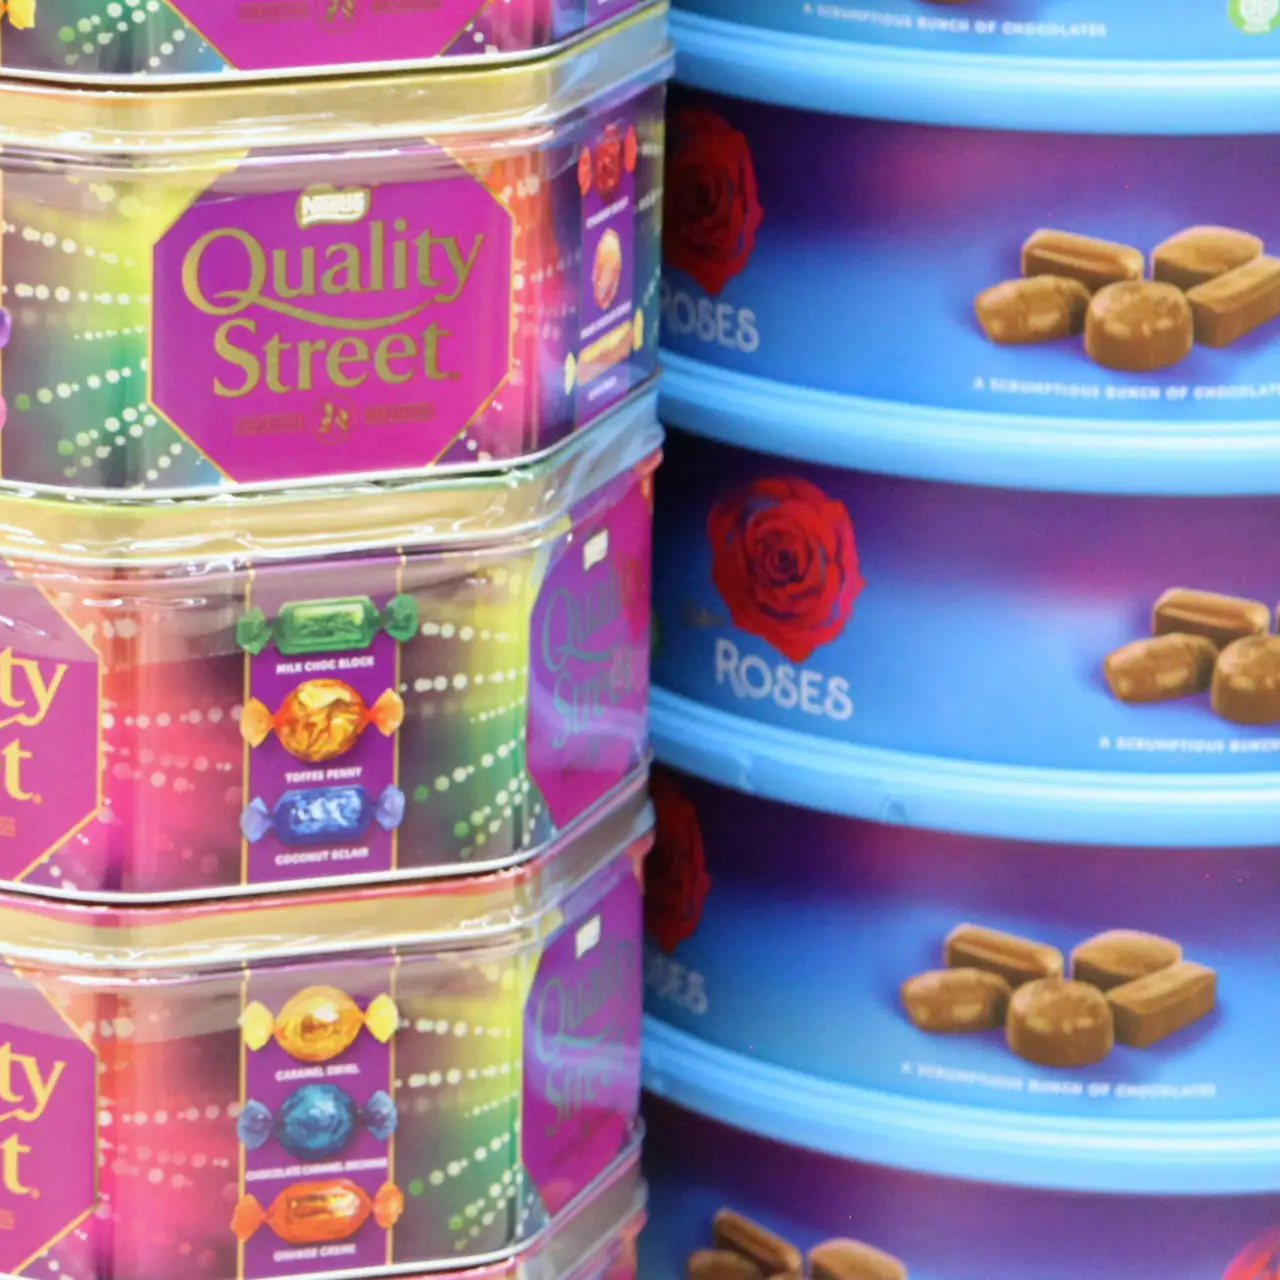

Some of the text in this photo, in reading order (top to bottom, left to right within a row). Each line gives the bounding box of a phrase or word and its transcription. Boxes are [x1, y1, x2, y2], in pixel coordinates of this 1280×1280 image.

[181, 219, 484, 329] Quality
[212, 320, 452, 398] Street
[276, 656, 374, 674] MILK CHOC BLOCK
[715, 637, 853, 720] ROSES
[286, 767, 361, 782] TOFFEE PENNY
[275, 847, 369, 865] COCONUT ECLAIR
